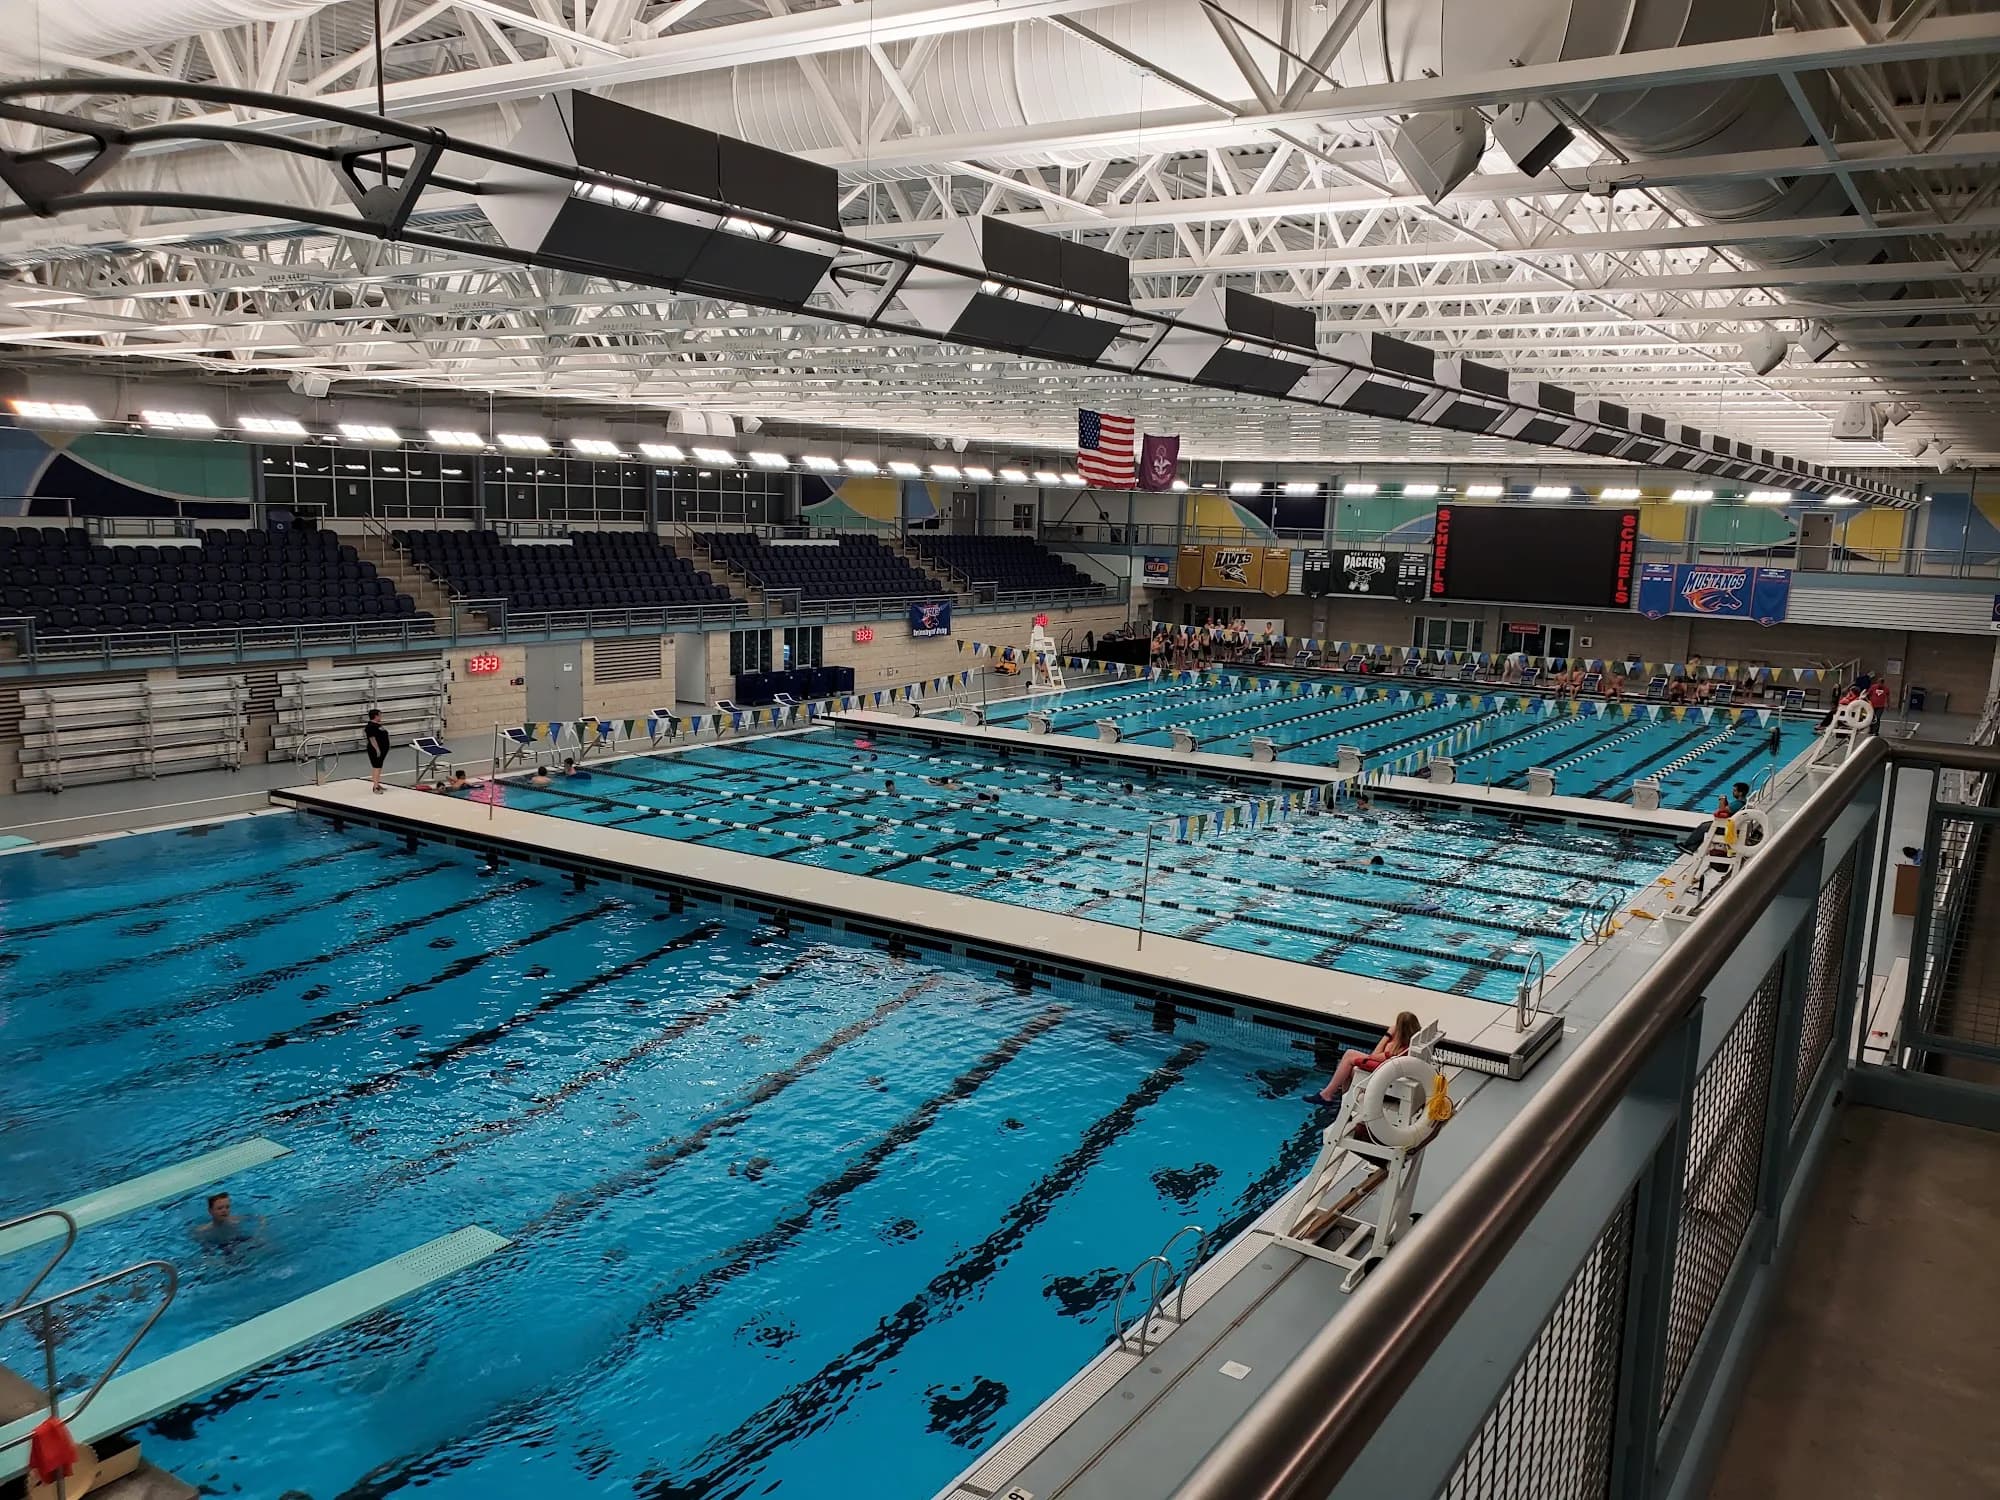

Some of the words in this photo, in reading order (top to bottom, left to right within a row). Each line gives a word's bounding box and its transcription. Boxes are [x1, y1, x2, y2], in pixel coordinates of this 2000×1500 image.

[1213, 552, 1253, 568] HAWKS
[1432, 509, 1451, 593] SCHEELS
[1615, 515, 1636, 604] SCHEELS
[1343, 554, 1386, 574] PACKERS
[1681, 571, 1746, 594] MUSTANGS
